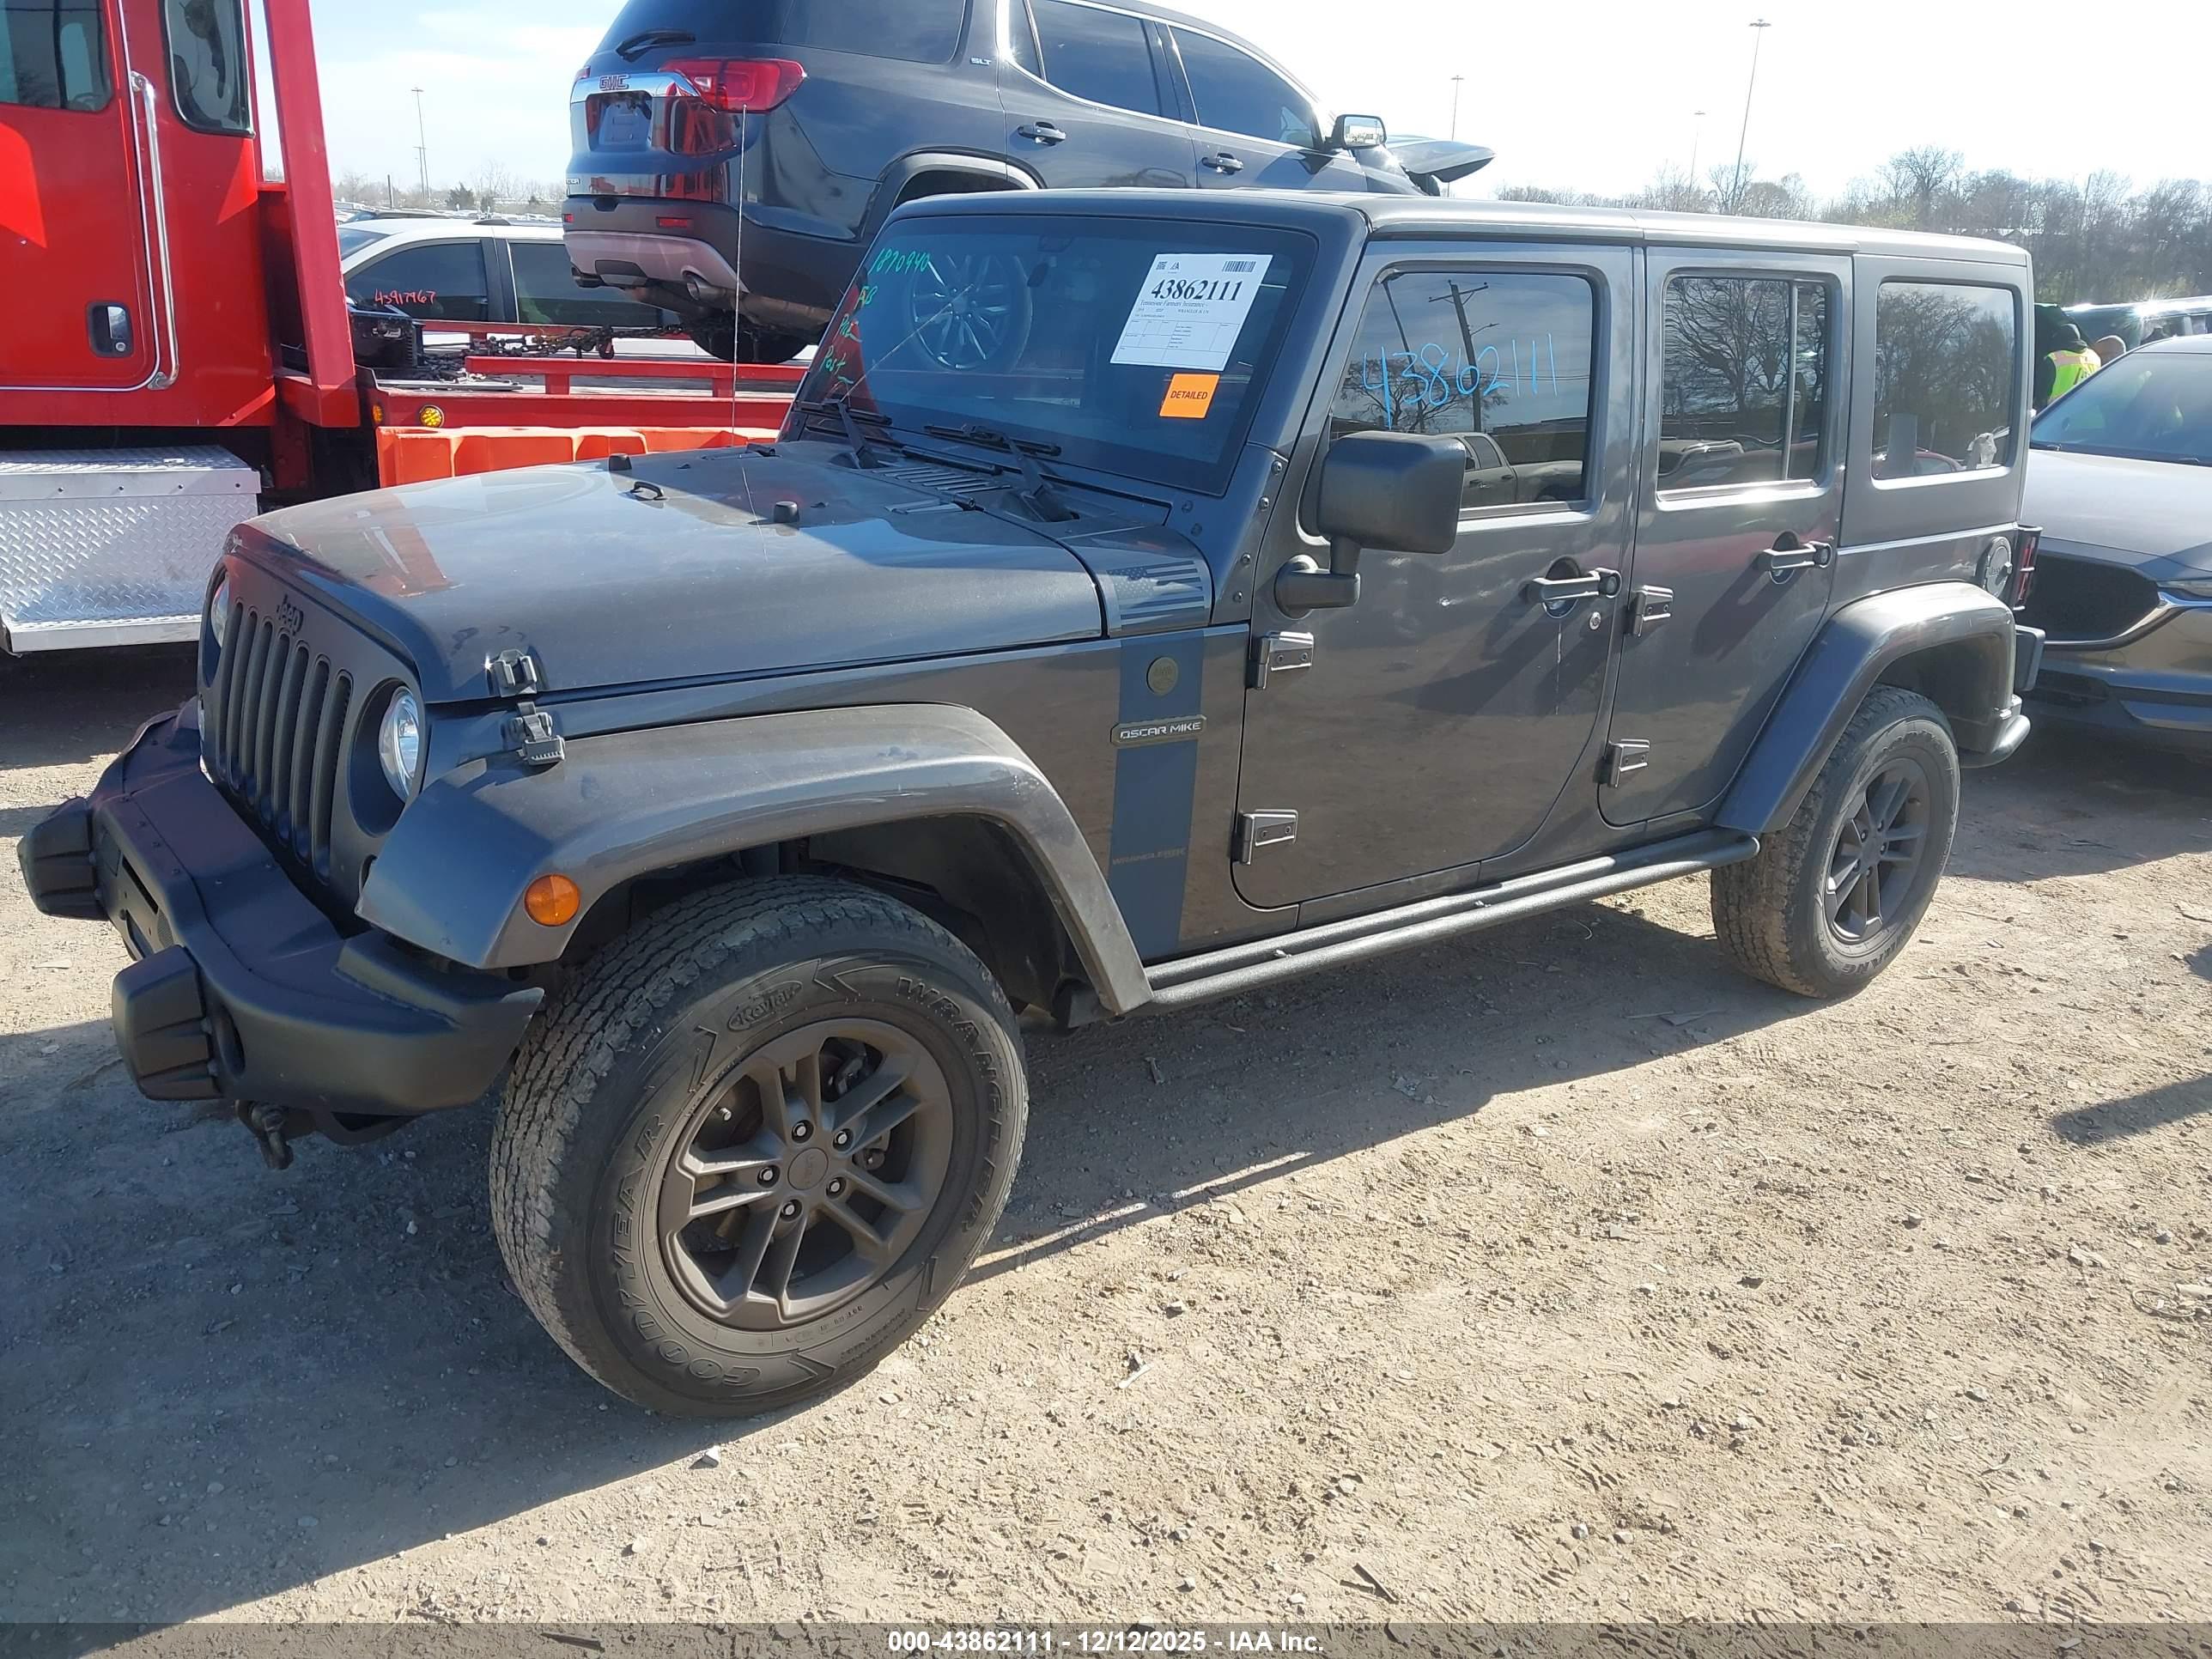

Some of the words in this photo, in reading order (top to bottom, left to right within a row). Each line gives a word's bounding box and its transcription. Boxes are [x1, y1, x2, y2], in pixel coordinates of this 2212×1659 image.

[970, 58, 992, 66] SLT
[599, 74, 630, 91] GMC
[1151, 279, 1243, 301] 43862111
[1364, 333, 1559, 430] 43862111
[1170, 390, 1208, 400] DETAILED
[276, 593, 305, 636] Jeep
[1120, 726, 1168, 739] OSCAR
[1170, 721, 1202, 733] MIKE
[896, 975, 1002, 1233] WRANGLER
[613, 1114, 762, 1386] GOODYEAR
